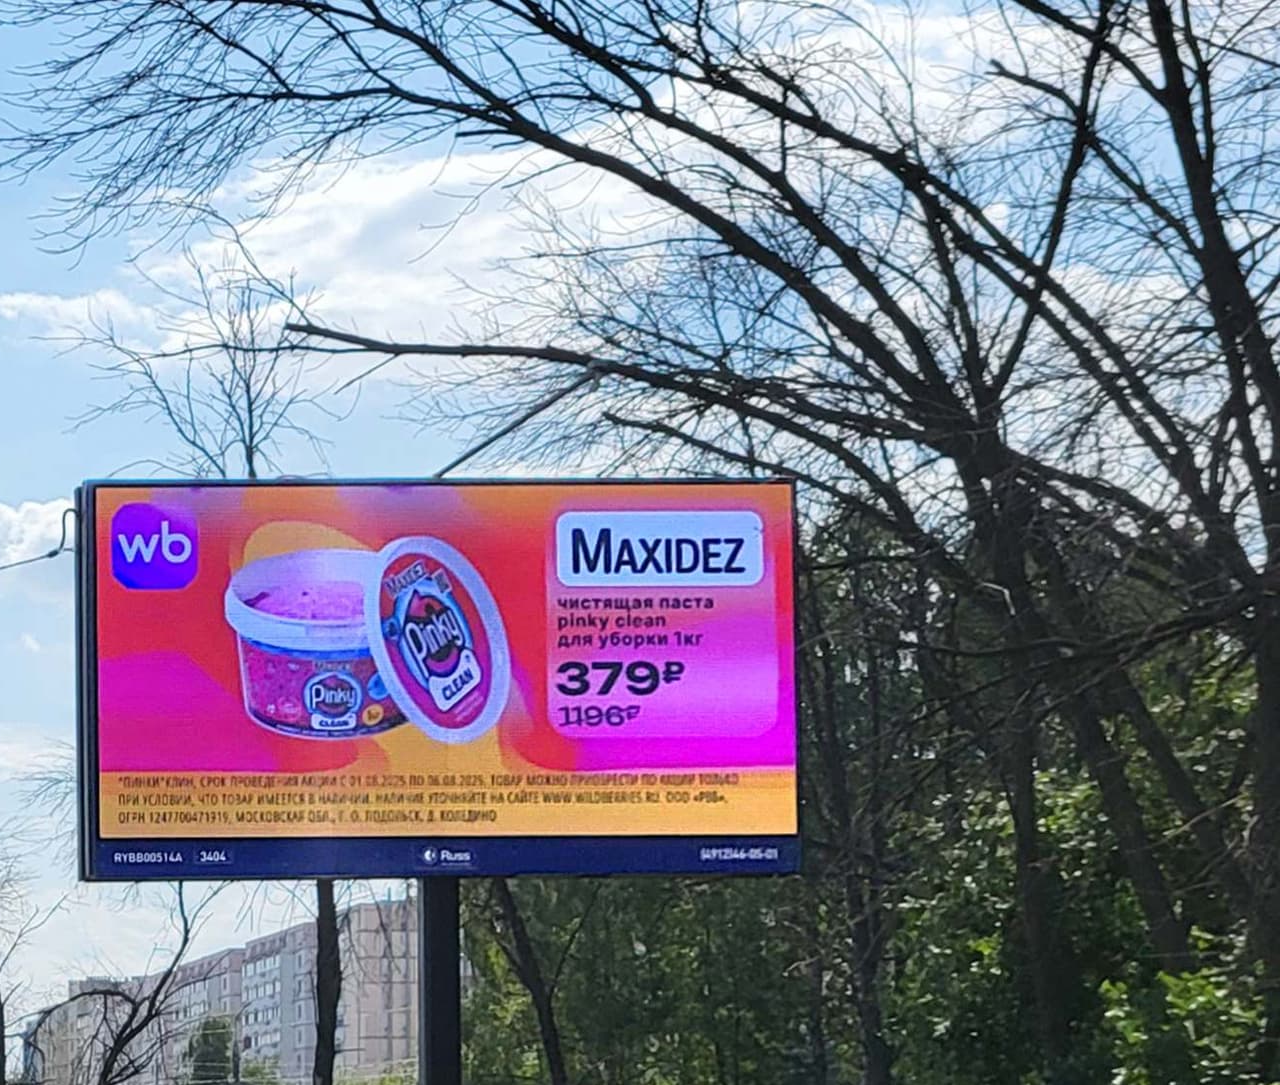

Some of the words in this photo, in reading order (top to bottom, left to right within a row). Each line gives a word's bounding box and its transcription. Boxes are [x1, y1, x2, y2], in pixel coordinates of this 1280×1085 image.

[118, 520, 192, 563] wb
[557, 597, 653, 612] чистящая
[659, 597, 714, 609] паста
[557, 613, 610, 630] pinky
[615, 613, 666, 627] clean
[557, 633, 593, 648] для
[599, 632, 668, 649] уборки
[673, 632, 703, 646] 1кг
[442, 668, 474, 700] CLEAN
[118, 793, 140, 806] ПРИ
[199, 793, 218, 805] ЧТО
[118, 812, 145, 824] ОГРН
[200, 850, 226, 861] 3404
